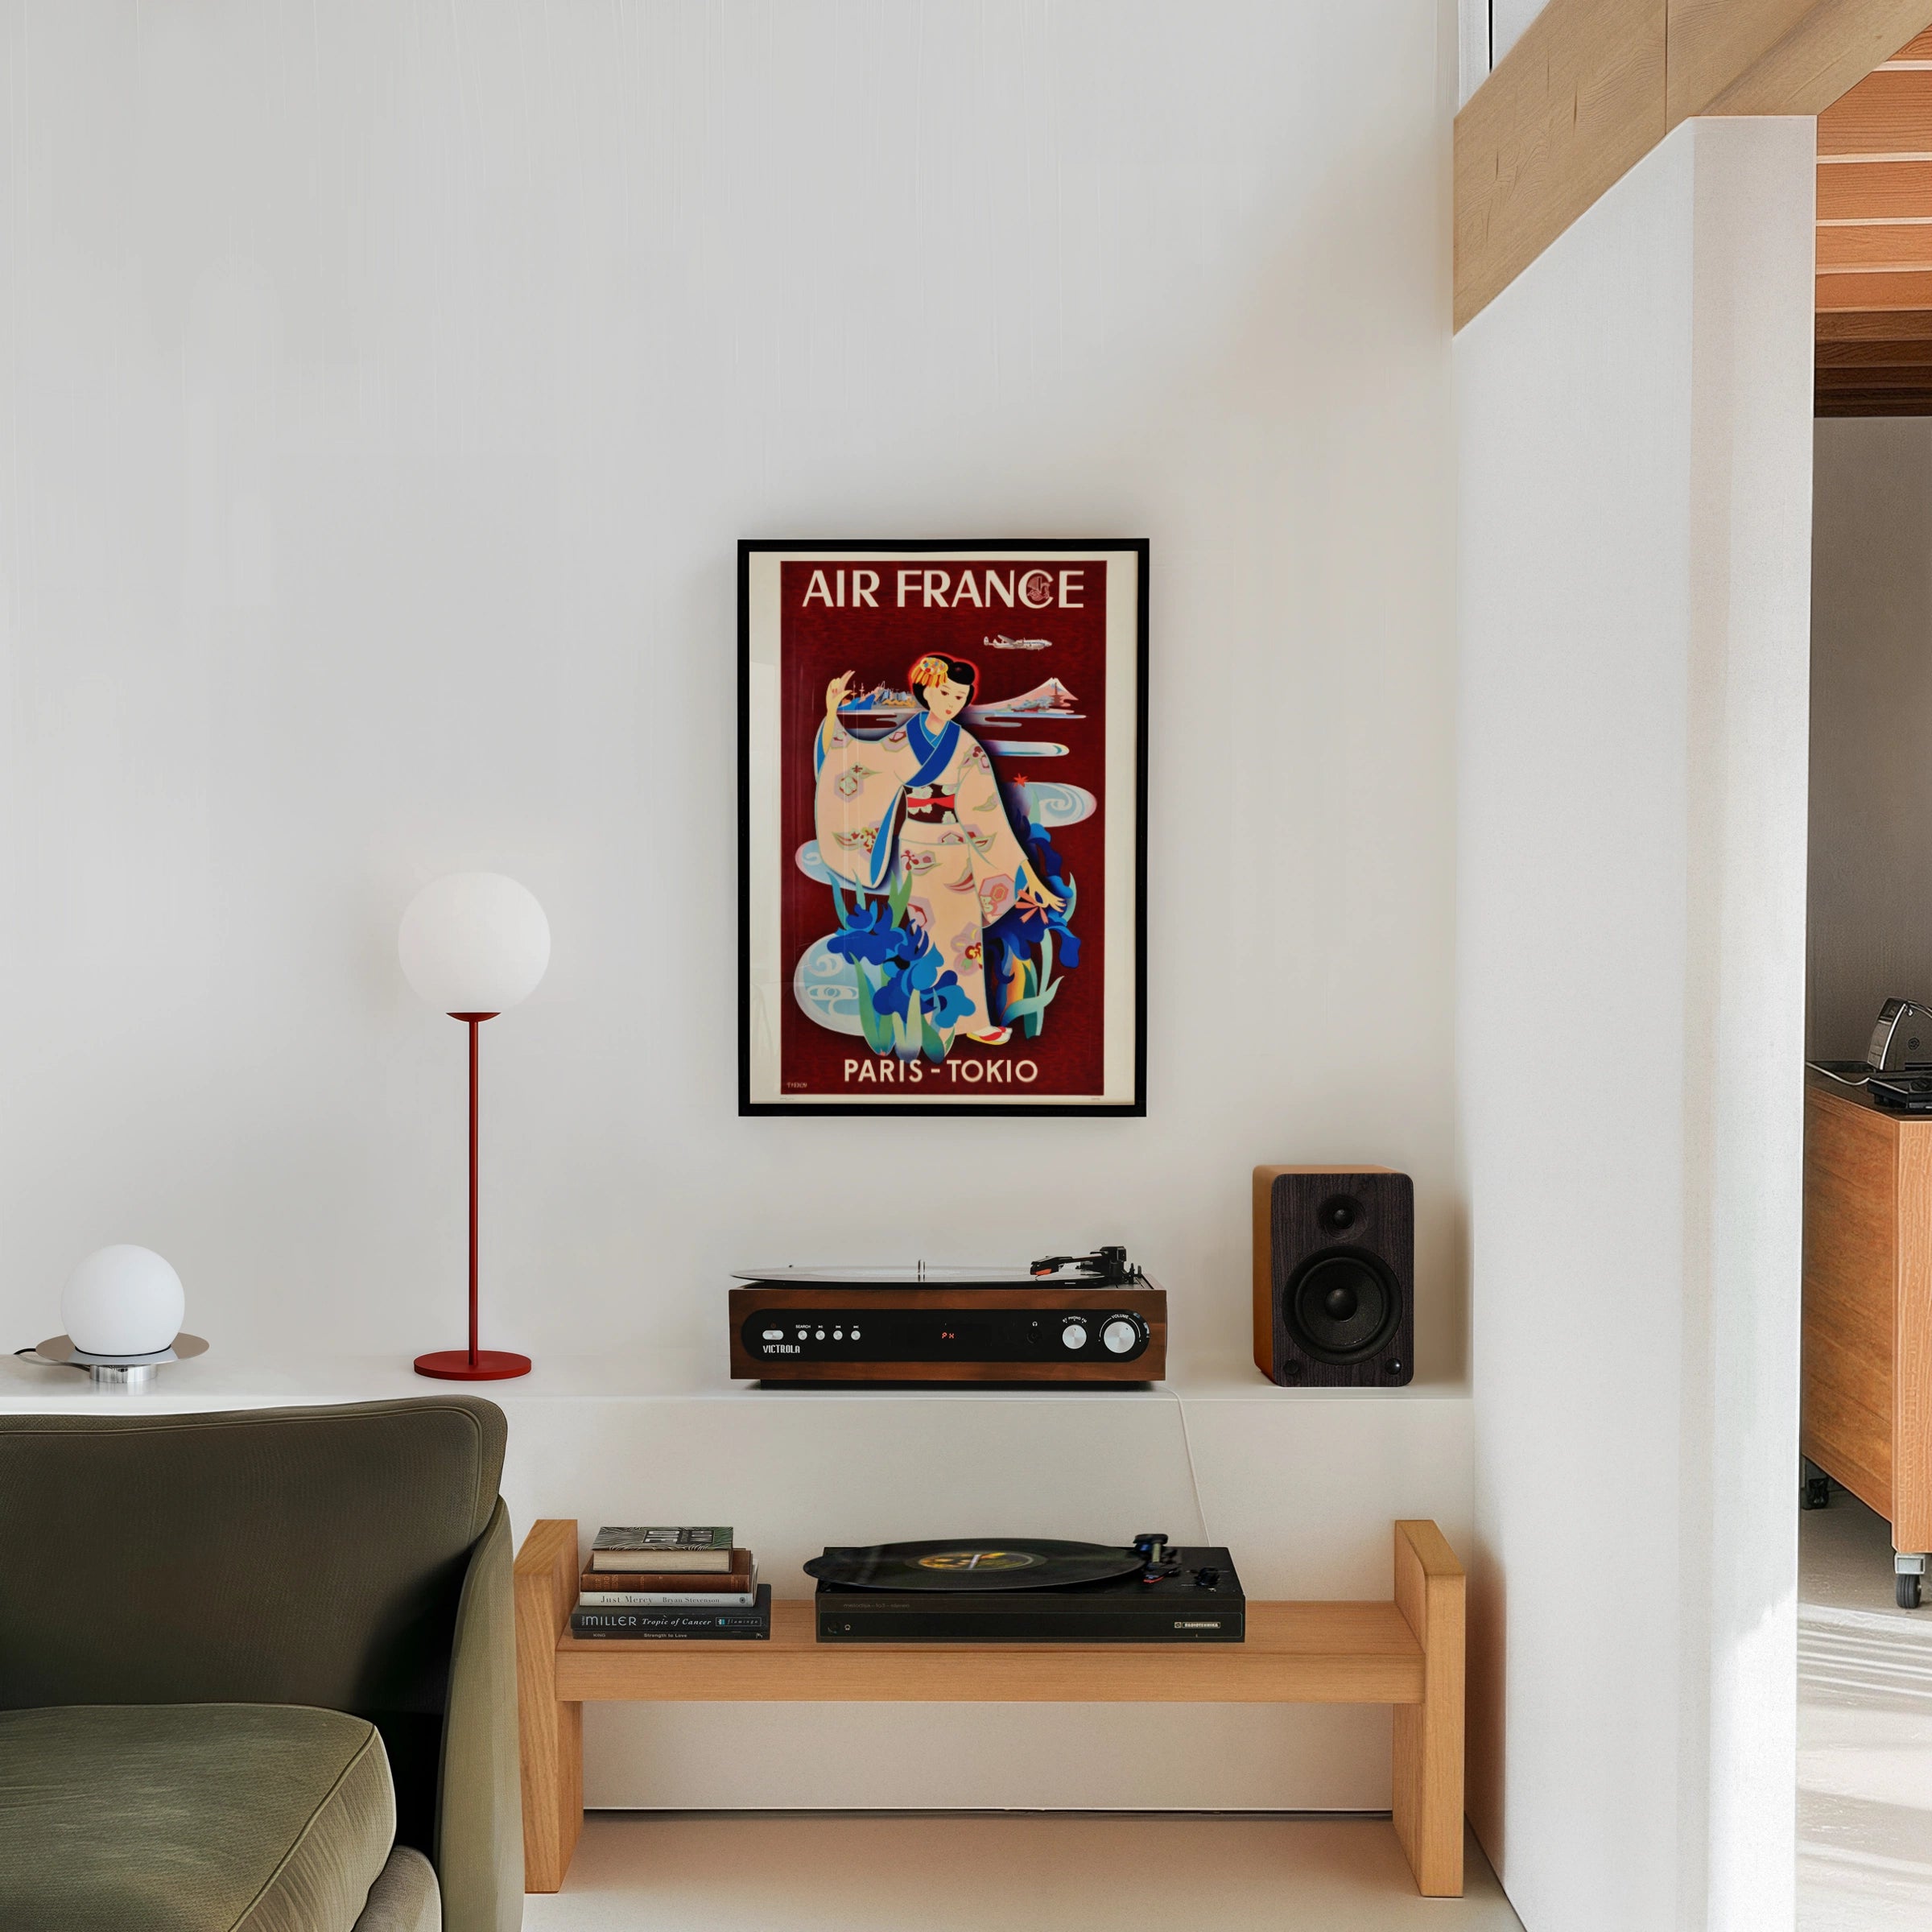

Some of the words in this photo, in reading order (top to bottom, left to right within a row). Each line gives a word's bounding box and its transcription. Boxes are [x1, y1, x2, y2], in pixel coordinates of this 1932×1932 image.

[802, 569, 880, 608] AIR
[897, 568, 1085, 609] FRANCE
[844, 1059, 923, 1083] PARIS
[946, 1059, 1038, 1083] TOKIO
[762, 1344, 800, 1354] VICTROLA
[601, 1596, 621, 1604] Just
[625, 1596, 653, 1605] Mercy
[663, 1596, 683, 1604] Bryan
[585, 1616, 637, 1626] MILLER
[642, 1617, 668, 1626] Tropic
[671, 1617, 679, 1626] of
[682, 1617, 712, 1625] Cancer
